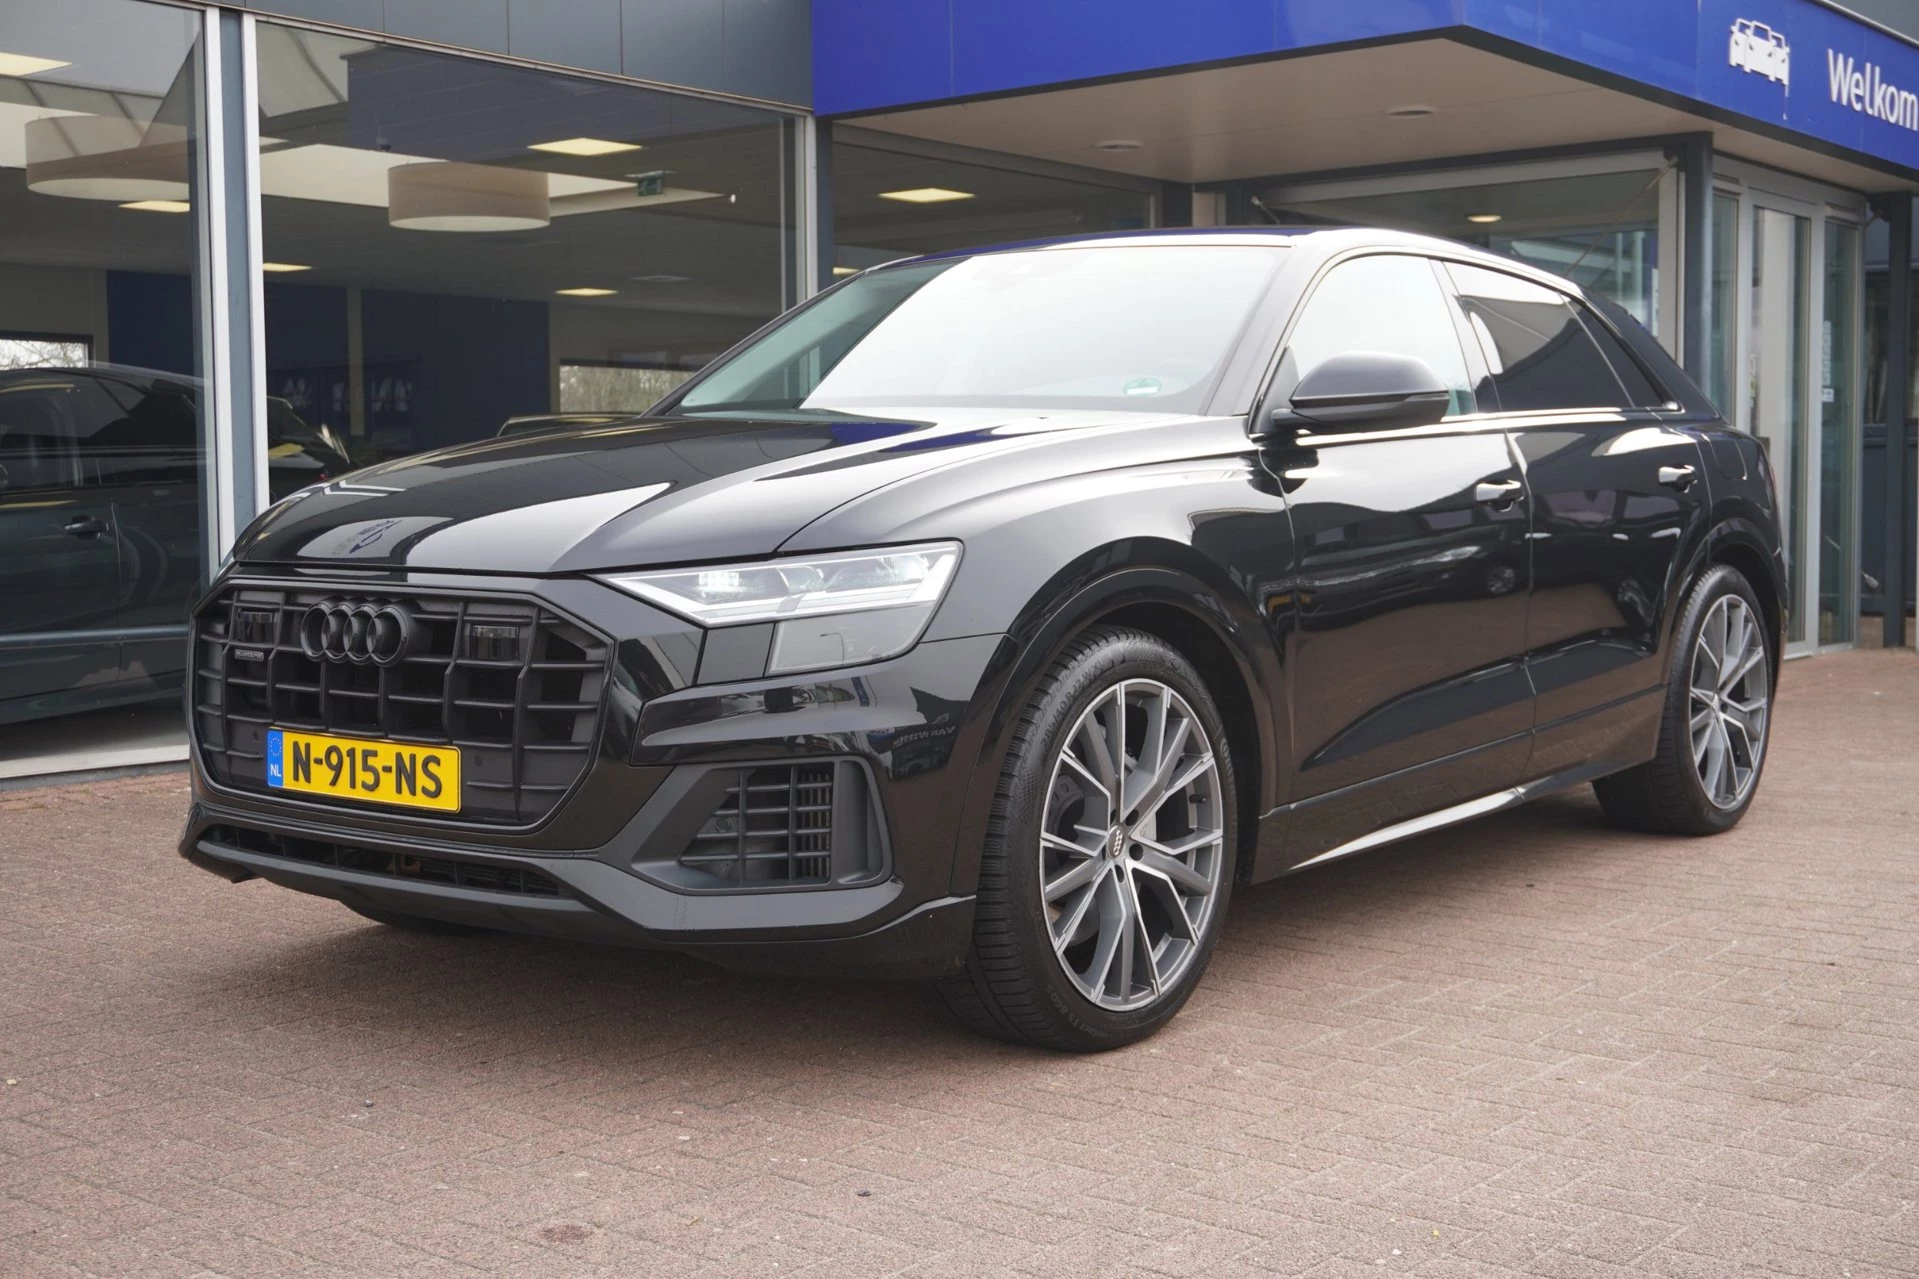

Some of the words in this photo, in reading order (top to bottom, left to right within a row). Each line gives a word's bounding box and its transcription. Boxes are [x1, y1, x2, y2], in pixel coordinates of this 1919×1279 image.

[1828, 48, 1919, 131] Welkom
[270, 764, 281, 776] NL
[292, 741, 442, 799] N-915-NS
